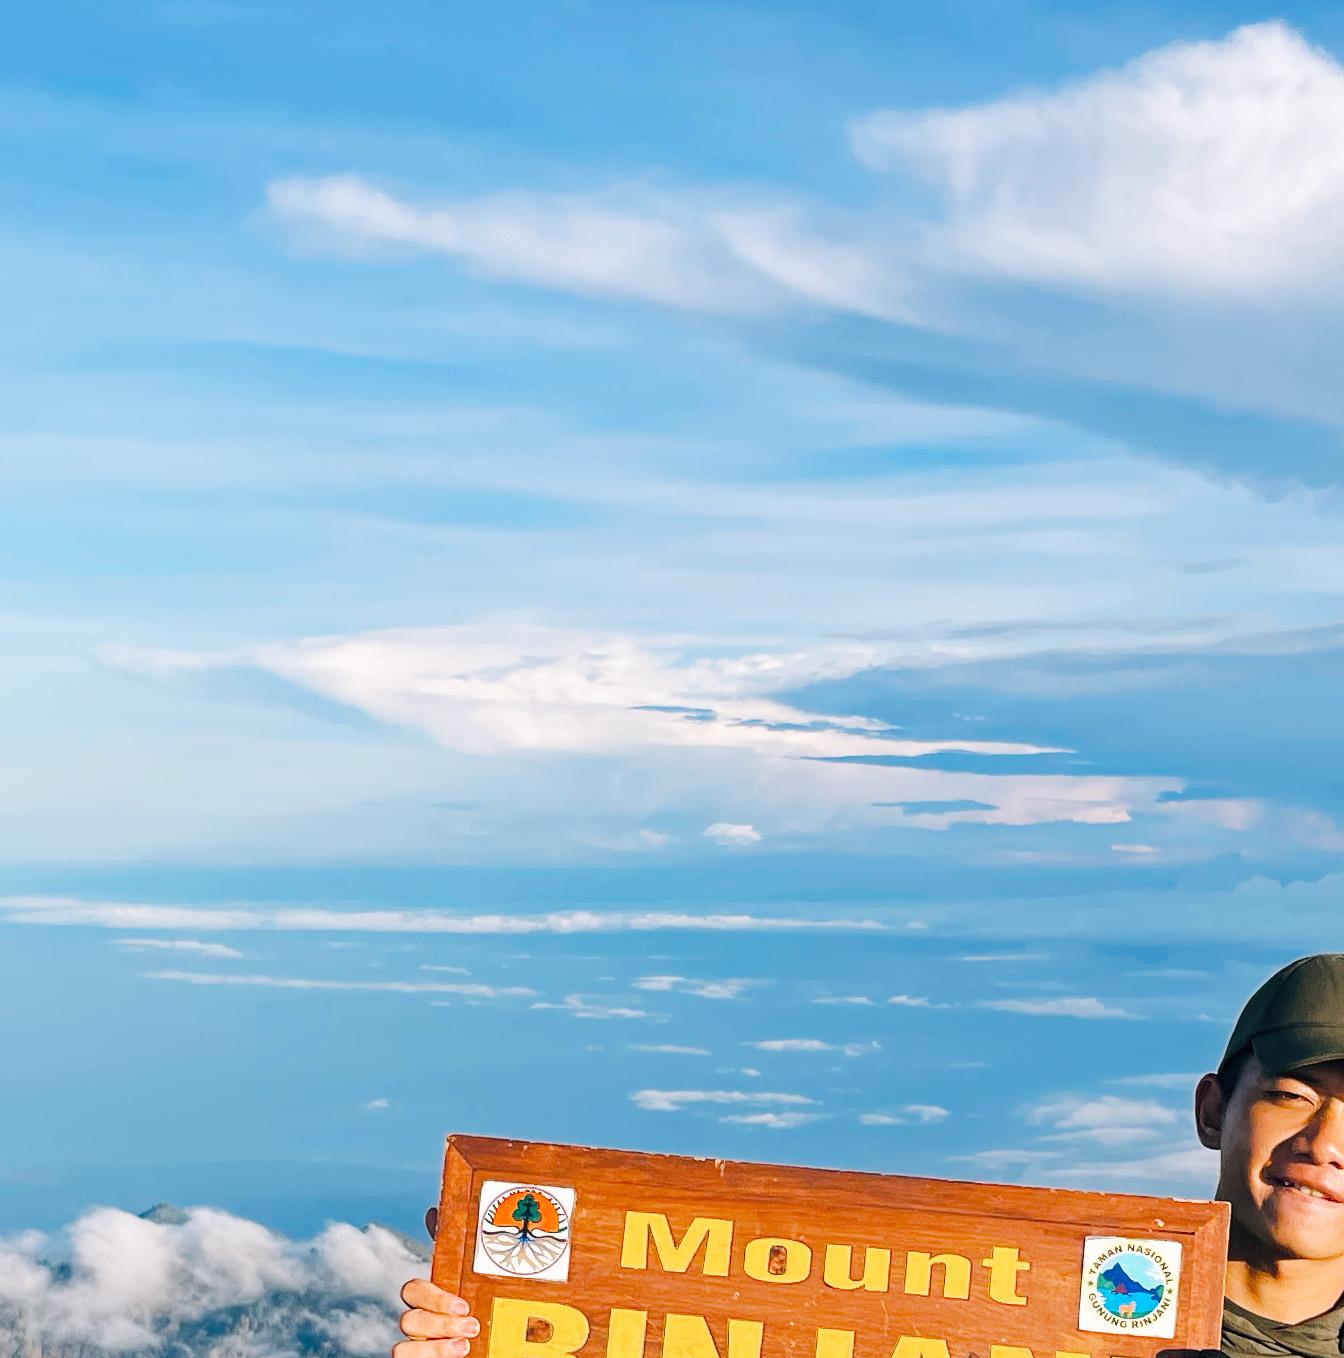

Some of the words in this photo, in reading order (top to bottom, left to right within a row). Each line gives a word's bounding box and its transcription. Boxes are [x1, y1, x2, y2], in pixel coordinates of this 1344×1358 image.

[620, 1211, 1031, 1305] Mount
[1088, 1244, 1123, 1276] TAMAN
[1127, 1243, 1174, 1285] NASIONAL
[1088, 1293, 1128, 1328] GUNUNG
[1131, 1297, 1172, 1329] RINJANI
